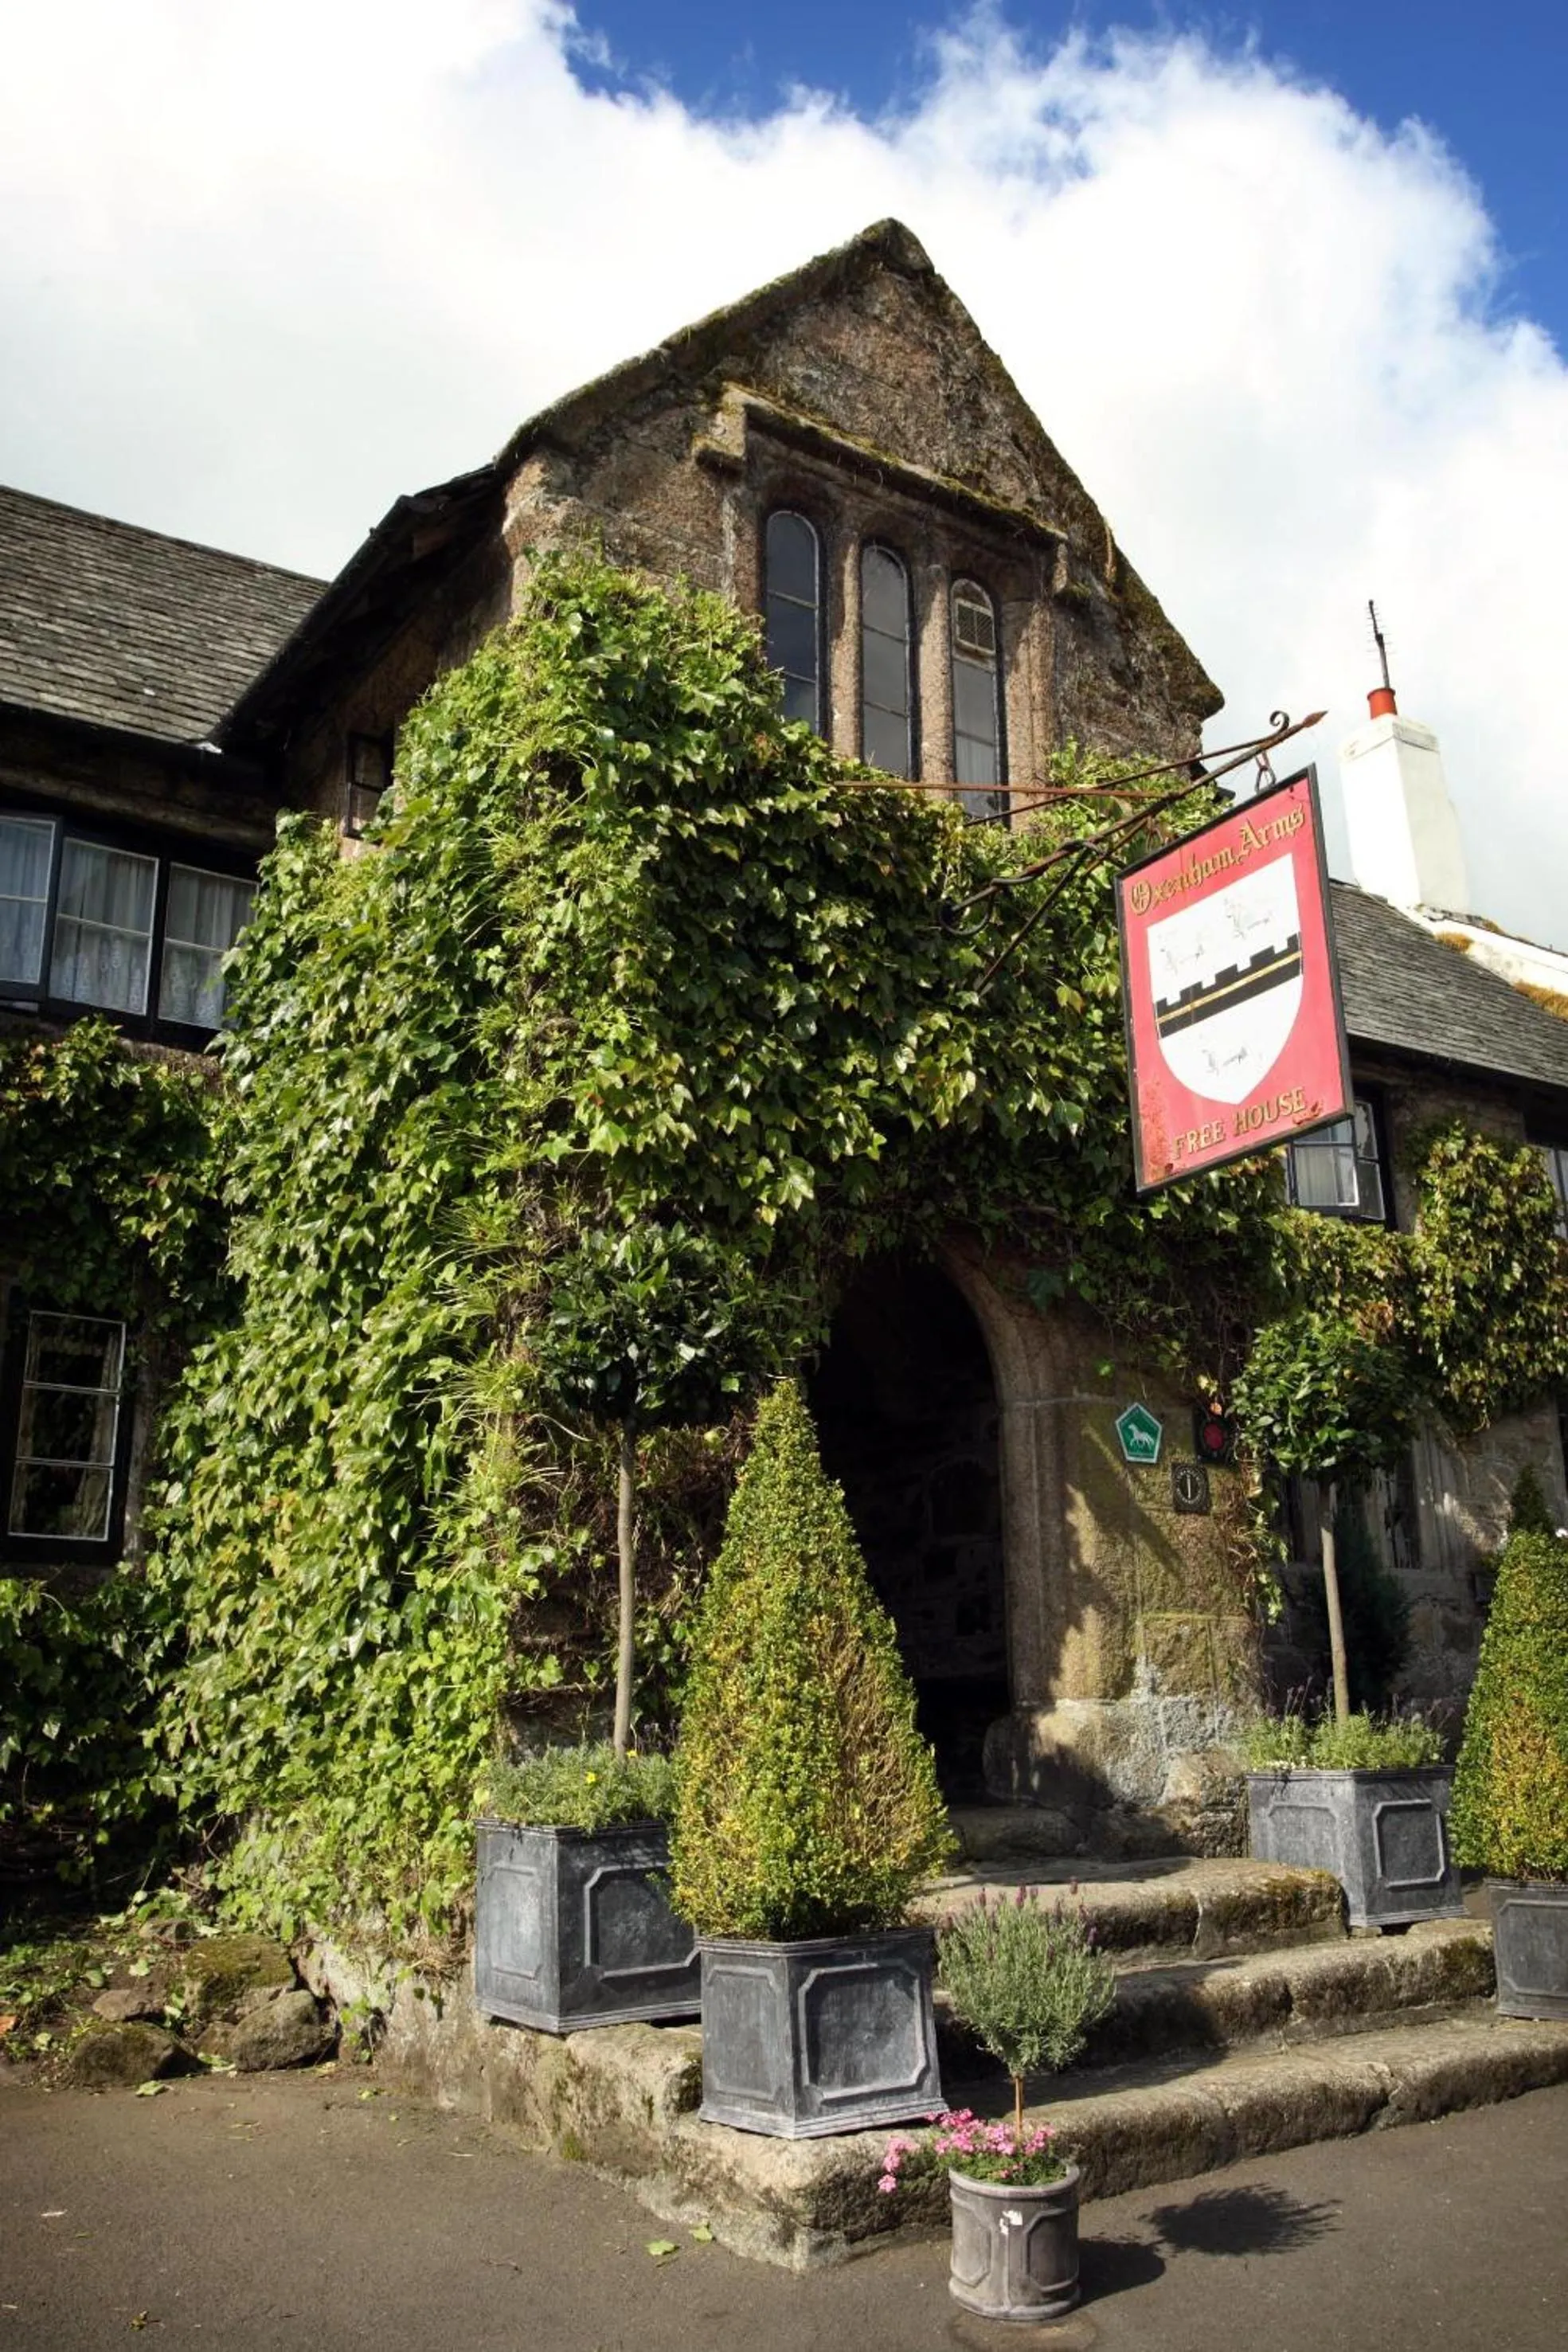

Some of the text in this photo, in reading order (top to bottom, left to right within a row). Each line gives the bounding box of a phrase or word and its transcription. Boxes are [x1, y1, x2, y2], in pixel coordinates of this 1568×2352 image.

[1130, 803, 1305, 915] Oxenham Arms
[1171, 1086, 1306, 1160] FREE HOUSE
